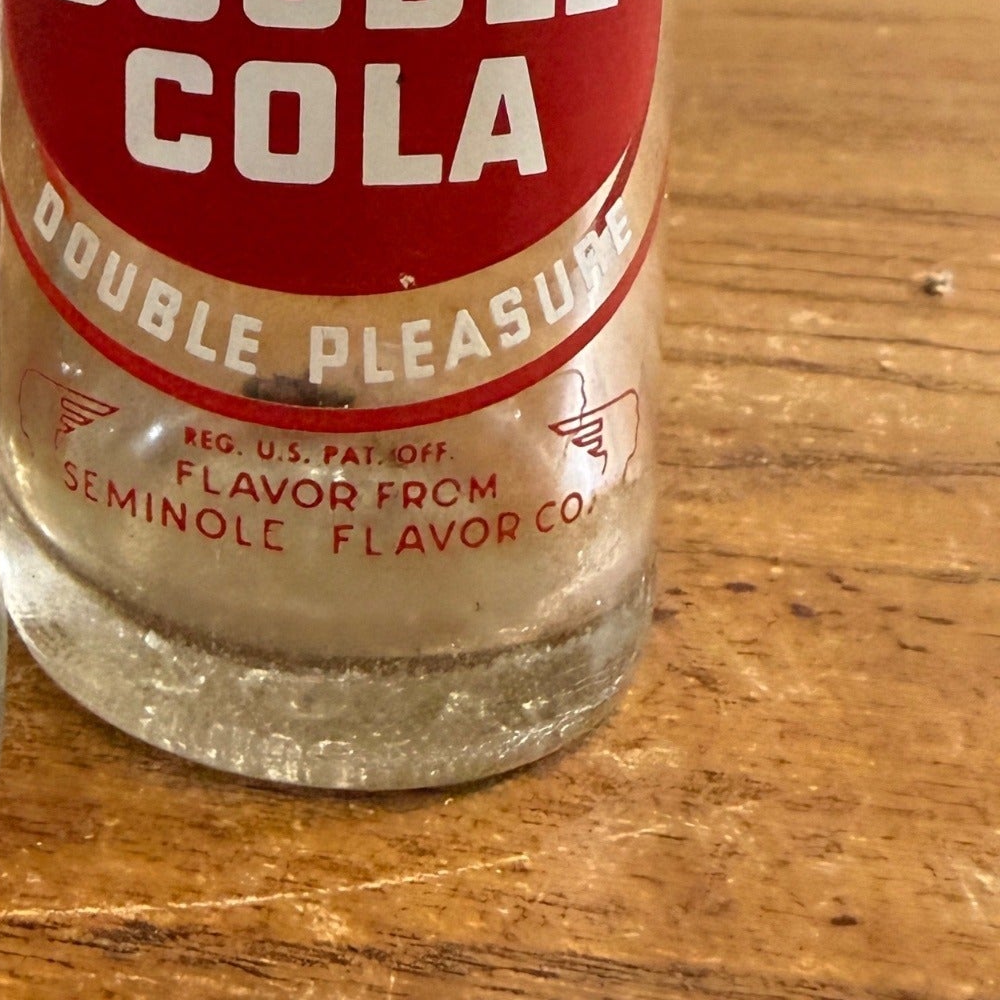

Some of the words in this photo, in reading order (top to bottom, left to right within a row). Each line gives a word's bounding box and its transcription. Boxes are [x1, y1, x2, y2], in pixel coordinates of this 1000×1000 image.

[124, 47, 548, 186] COLA
[33, 182, 263, 375] DOUBLE
[308, 197, 633, 385] PLEASURE
[177, 459, 358, 512] FLAVOR
[377, 472, 498, 510] FROM
[184, 426, 243, 457] REG.
[257, 439, 311, 465] U.S.
[323, 444, 384, 466] PAT.
[396, 441, 455, 465] OFF.
[63, 461, 284, 552] SEMINOLE
[333, 511, 521, 556] FLAVOR
